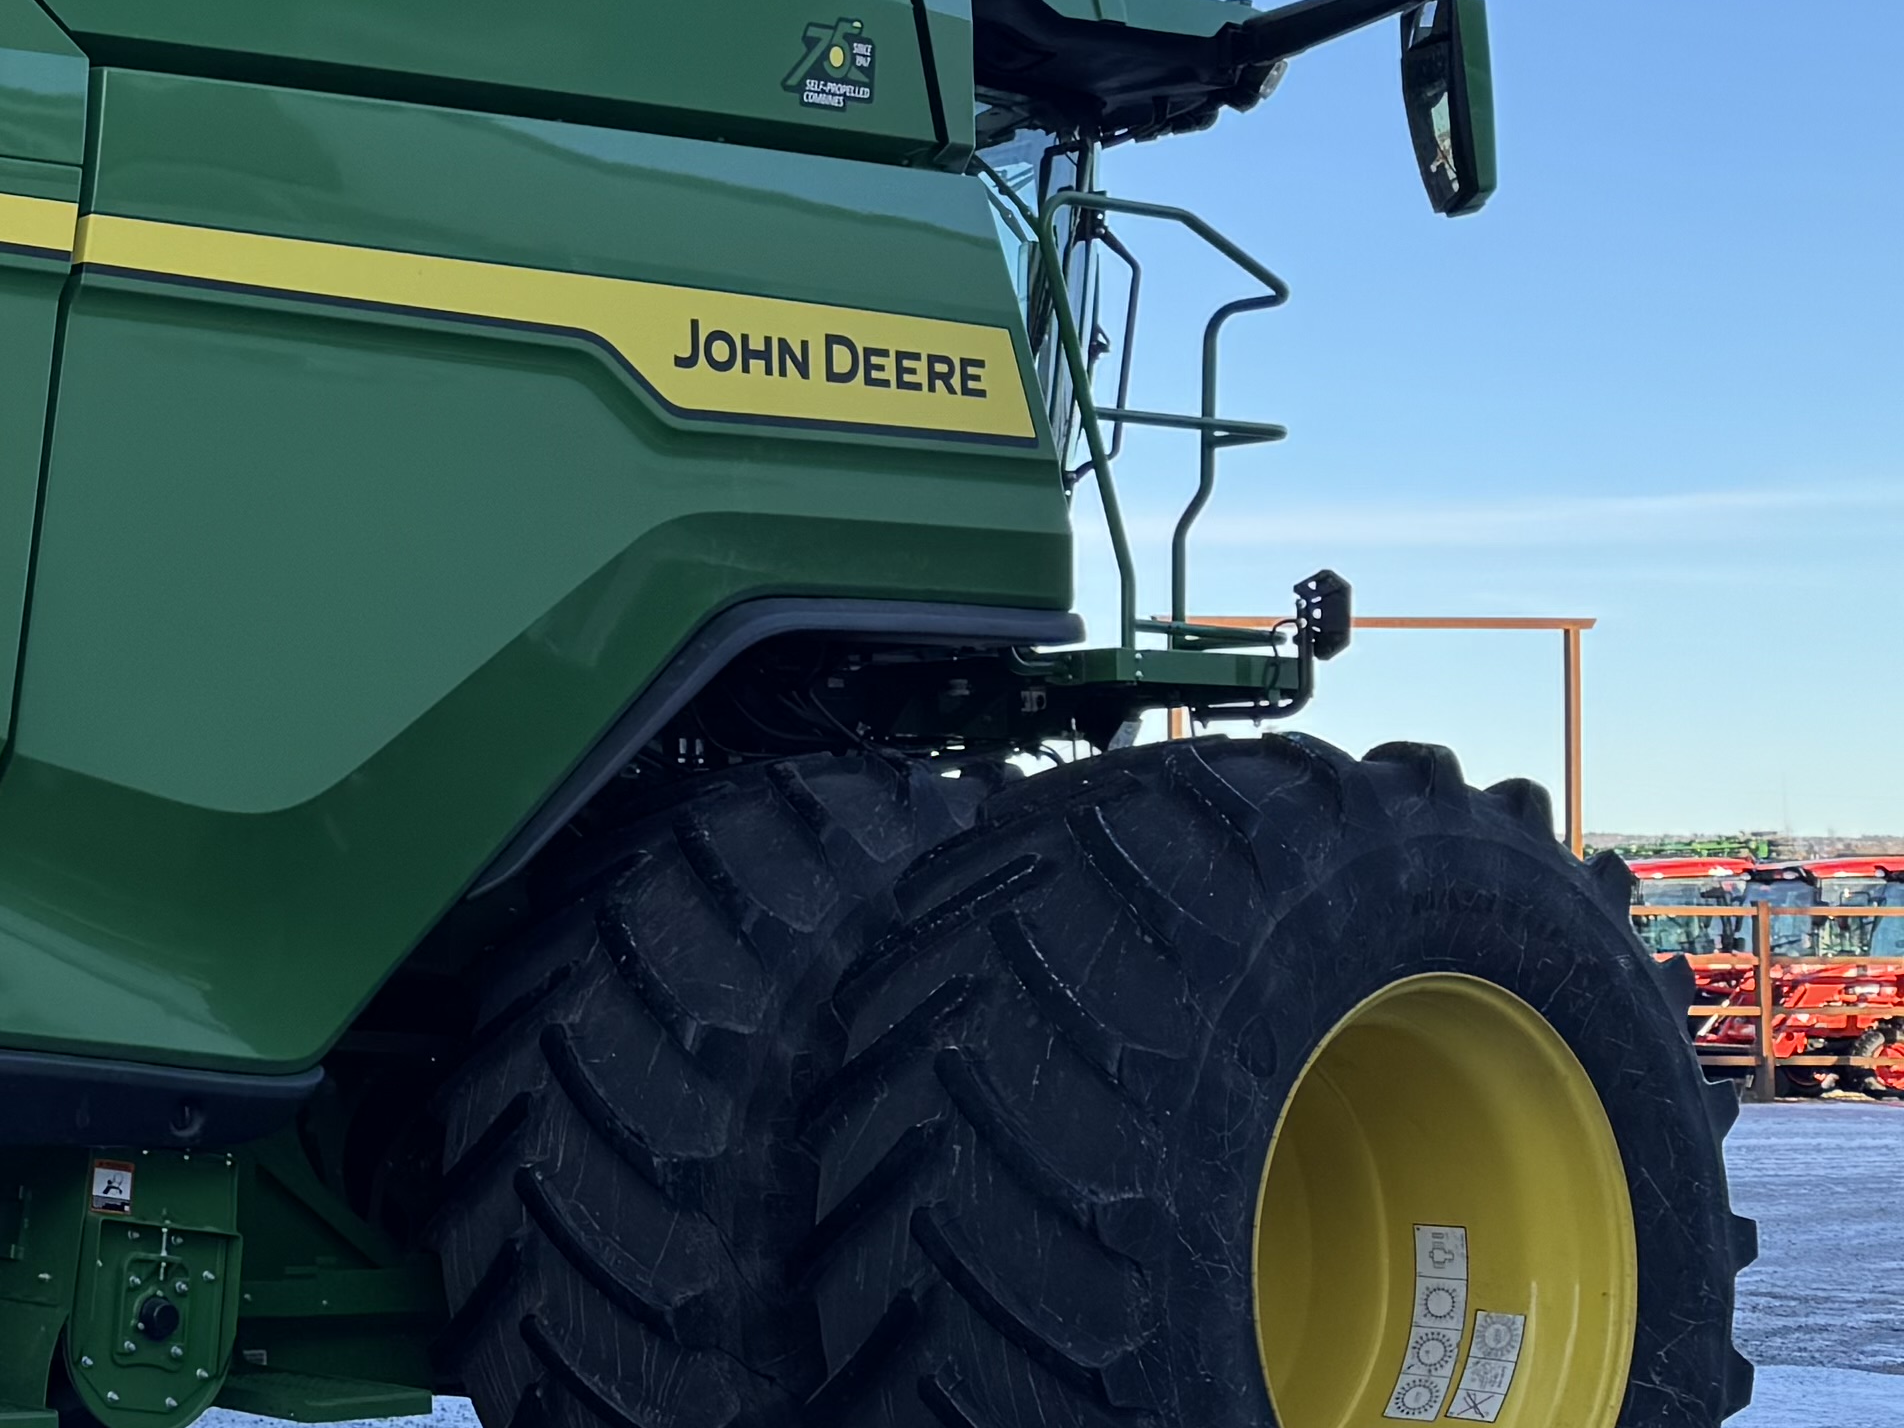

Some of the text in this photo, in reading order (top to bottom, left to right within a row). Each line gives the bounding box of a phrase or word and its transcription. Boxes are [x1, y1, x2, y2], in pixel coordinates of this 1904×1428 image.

[805, 78, 871, 99] SELF-PROPELLED
[673, 319, 988, 399] JOHN DEERE
